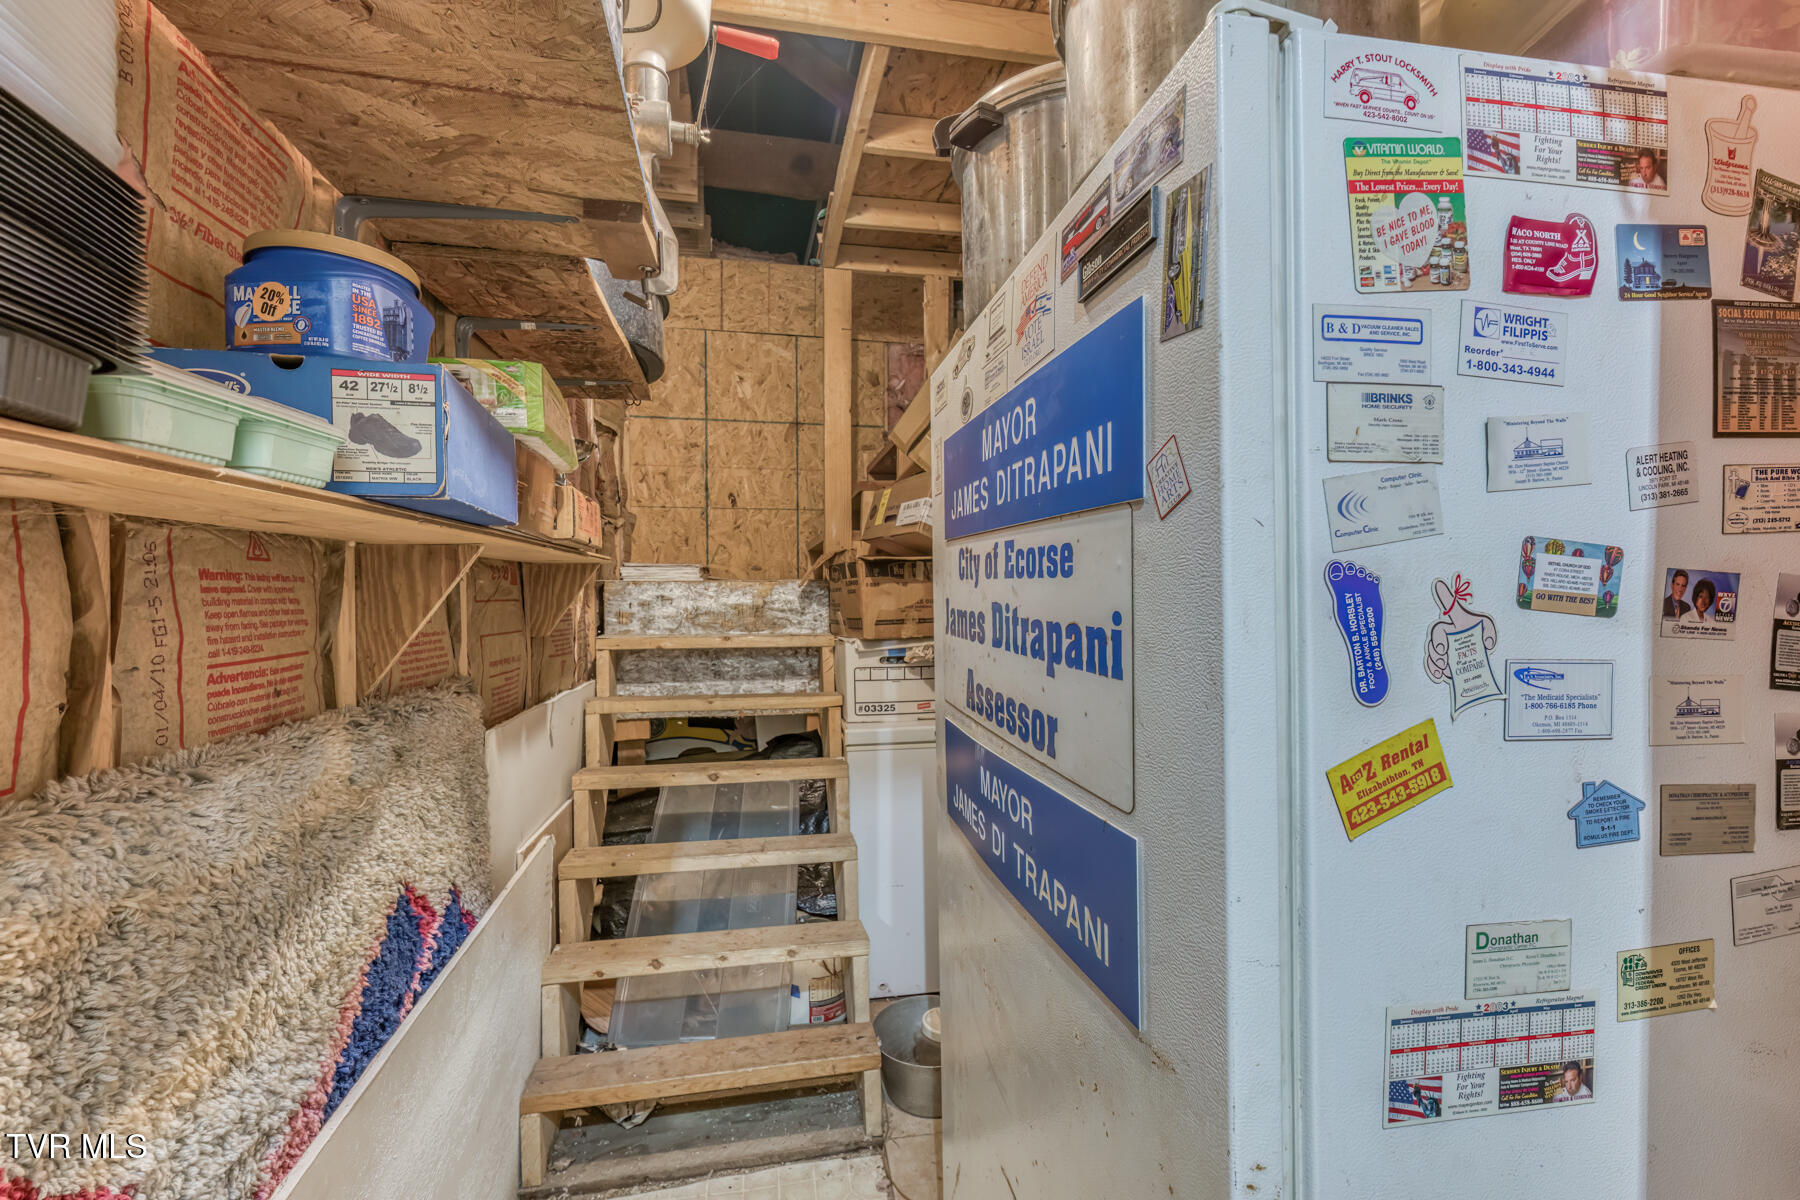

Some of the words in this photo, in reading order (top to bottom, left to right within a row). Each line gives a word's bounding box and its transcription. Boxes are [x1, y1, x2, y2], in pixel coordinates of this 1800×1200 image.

[1331, 59, 1356, 83] HARRY
[1356, 56, 1365, 65] T.
[1366, 53, 1393, 63] STOUT
[1394, 57, 1438, 97] LOCKSMITH
[1483, 62, 1503, 71] Display
[1517, 66, 1532, 74] Pride
[1637, 80, 1656, 89] Magnet
[1362, 110, 1408, 123] 423-542-8002
[1533, 135, 1563, 147] Fighting
[1366, 143, 1406, 155] VITAMIN
[1407, 143, 1445, 156] WORLD
[1533, 145, 1547, 154] For
[1548, 146, 1563, 155] Your
[1536, 154, 1561, 165] Rights!
[1364, 169, 1381, 177] Direct
[1403, 169, 1439, 179] Manufacturer
[1355, 182, 1370, 192] The
[1370, 182, 1395, 192] Lowest
[1442, 181, 1459, 193] Day!
[1376, 226, 1386, 238] BE
[1388, 216, 1405, 231] NICE
[1407, 212, 1418, 223] TO
[1420, 204, 1434, 218] ME,
[194, 222, 224, 250] Fiber
[1390, 230, 1409, 246] GAVE
[1411, 217, 1435, 234] BLOOD
[1511, 227, 1533, 238] WACO
[1533, 229, 1561, 241] NORTH
[1401, 236, 1427, 256] TODAY!
[1083, 255, 1103, 280] Gibson
[259, 286, 285, 306] 20%
[352, 288, 358, 297] IN
[359, 290, 372, 301] THE
[1644, 291, 1657, 299] Good
[352, 294, 376, 311] USA
[260, 303, 277, 317] Off
[352, 304, 377, 319] SINCE
[1718, 307, 1741, 319] SOCIAL
[1743, 308, 1774, 320] SECURITY
[352, 313, 383, 333] 1892.
[1502, 312, 1549, 328] WRIGHT
[352, 323, 373, 335] TRUSTED
[1326, 322, 1335, 333] B
[1338, 323, 1349, 334] &
[1352, 324, 1361, 335] D
[1502, 325, 1548, 341] FILIPPIS
[1466, 358, 1555, 378] 1-800-343-4944
[357, 370, 381, 379] WIDE
[382, 372, 411, 381] WIDTH
[339, 380, 359, 394] 42
[1370, 392, 1413, 405] BRINKS
[982, 397, 1036, 463] MAYOR
[1636, 453, 1658, 466] ALERT
[1659, 450, 1688, 463] HEATING
[951, 477, 988, 521] JAMES
[996, 421, 1113, 506] DITRAPANI
[1636, 469, 1641, 478] &
[1642, 464, 1675, 477] COOLING,
[1676, 461, 1690, 473] INC.
[1770, 468, 1788, 476] PURE
[1380, 474, 1408, 484] Computer
[1408, 472, 1423, 480] Clinic
[1640, 492, 1658, 503] (313)
[1658, 488, 1689, 500] 381-2665
[1334, 526, 1363, 538] Computer
[1362, 523, 1379, 534] Clinic
[958, 546, 981, 589] City
[984, 542, 999, 580] of
[1004, 540, 1074, 579] Ecorse
[198, 568, 243, 584] Warning:
[202, 597, 231, 608] building
[1546, 594, 1564, 602] WITH
[1578, 597, 1596, 605] BEST
[205, 610, 222, 621] Keep
[223, 610, 239, 620] open
[1344, 592, 1359, 634] HORSLEY
[1354, 592, 1367, 636] SPECIALIST
[206, 624, 224, 633] away
[224, 623, 241, 632] from
[1366, 606, 1379, 648] 559-5200
[207, 636, 219, 646] fire
[945, 597, 986, 646] James
[991, 601, 1124, 680] Ditrapani
[208, 650, 220, 659] call
[1361, 636, 1371, 660] ANKLE
[1457, 648, 1478, 661] FACTS
[1355, 644, 1367, 677] BARTON
[1374, 647, 1383, 671] (248)
[1455, 659, 1485, 676] COMPARE
[207, 666, 269, 687] Advertencia:
[1368, 667, 1376, 689] FOOT
[1360, 678, 1368, 694] DR.
[207, 689, 231, 701] puede
[1536, 693, 1563, 701] Medicaid
[858, 704, 896, 716] #03325
[1577, 701, 1597, 710] Phone
[965, 667, 1059, 760] Assessor
[1380, 733, 1429, 772] Rental
[1411, 758, 1424, 771] TN
[980, 765, 1034, 836] MAYOR
[1350, 767, 1441, 825] 423-543-5918
[953, 783, 987, 842] JAMES
[991, 822, 1006, 863] DI
[1012, 841, 1111, 968] TRAPANI
[1475, 931, 1539, 951] Donathan
[1678, 945, 1701, 956] OFFICES
[1535, 996, 1565, 1005] Refrigerator
[1565, 993, 1585, 1002] Magnet
[1410, 1007, 1431, 1016] Display
[1431, 1006, 1445, 1014] with
[1445, 1005, 1460, 1013] Pride
[1456, 1072, 1486, 1083] Fighting
[1456, 1082, 1469, 1091] For
[1470, 1081, 1485, 1090] Your
[1458, 1089, 1484, 1102] Rights!
